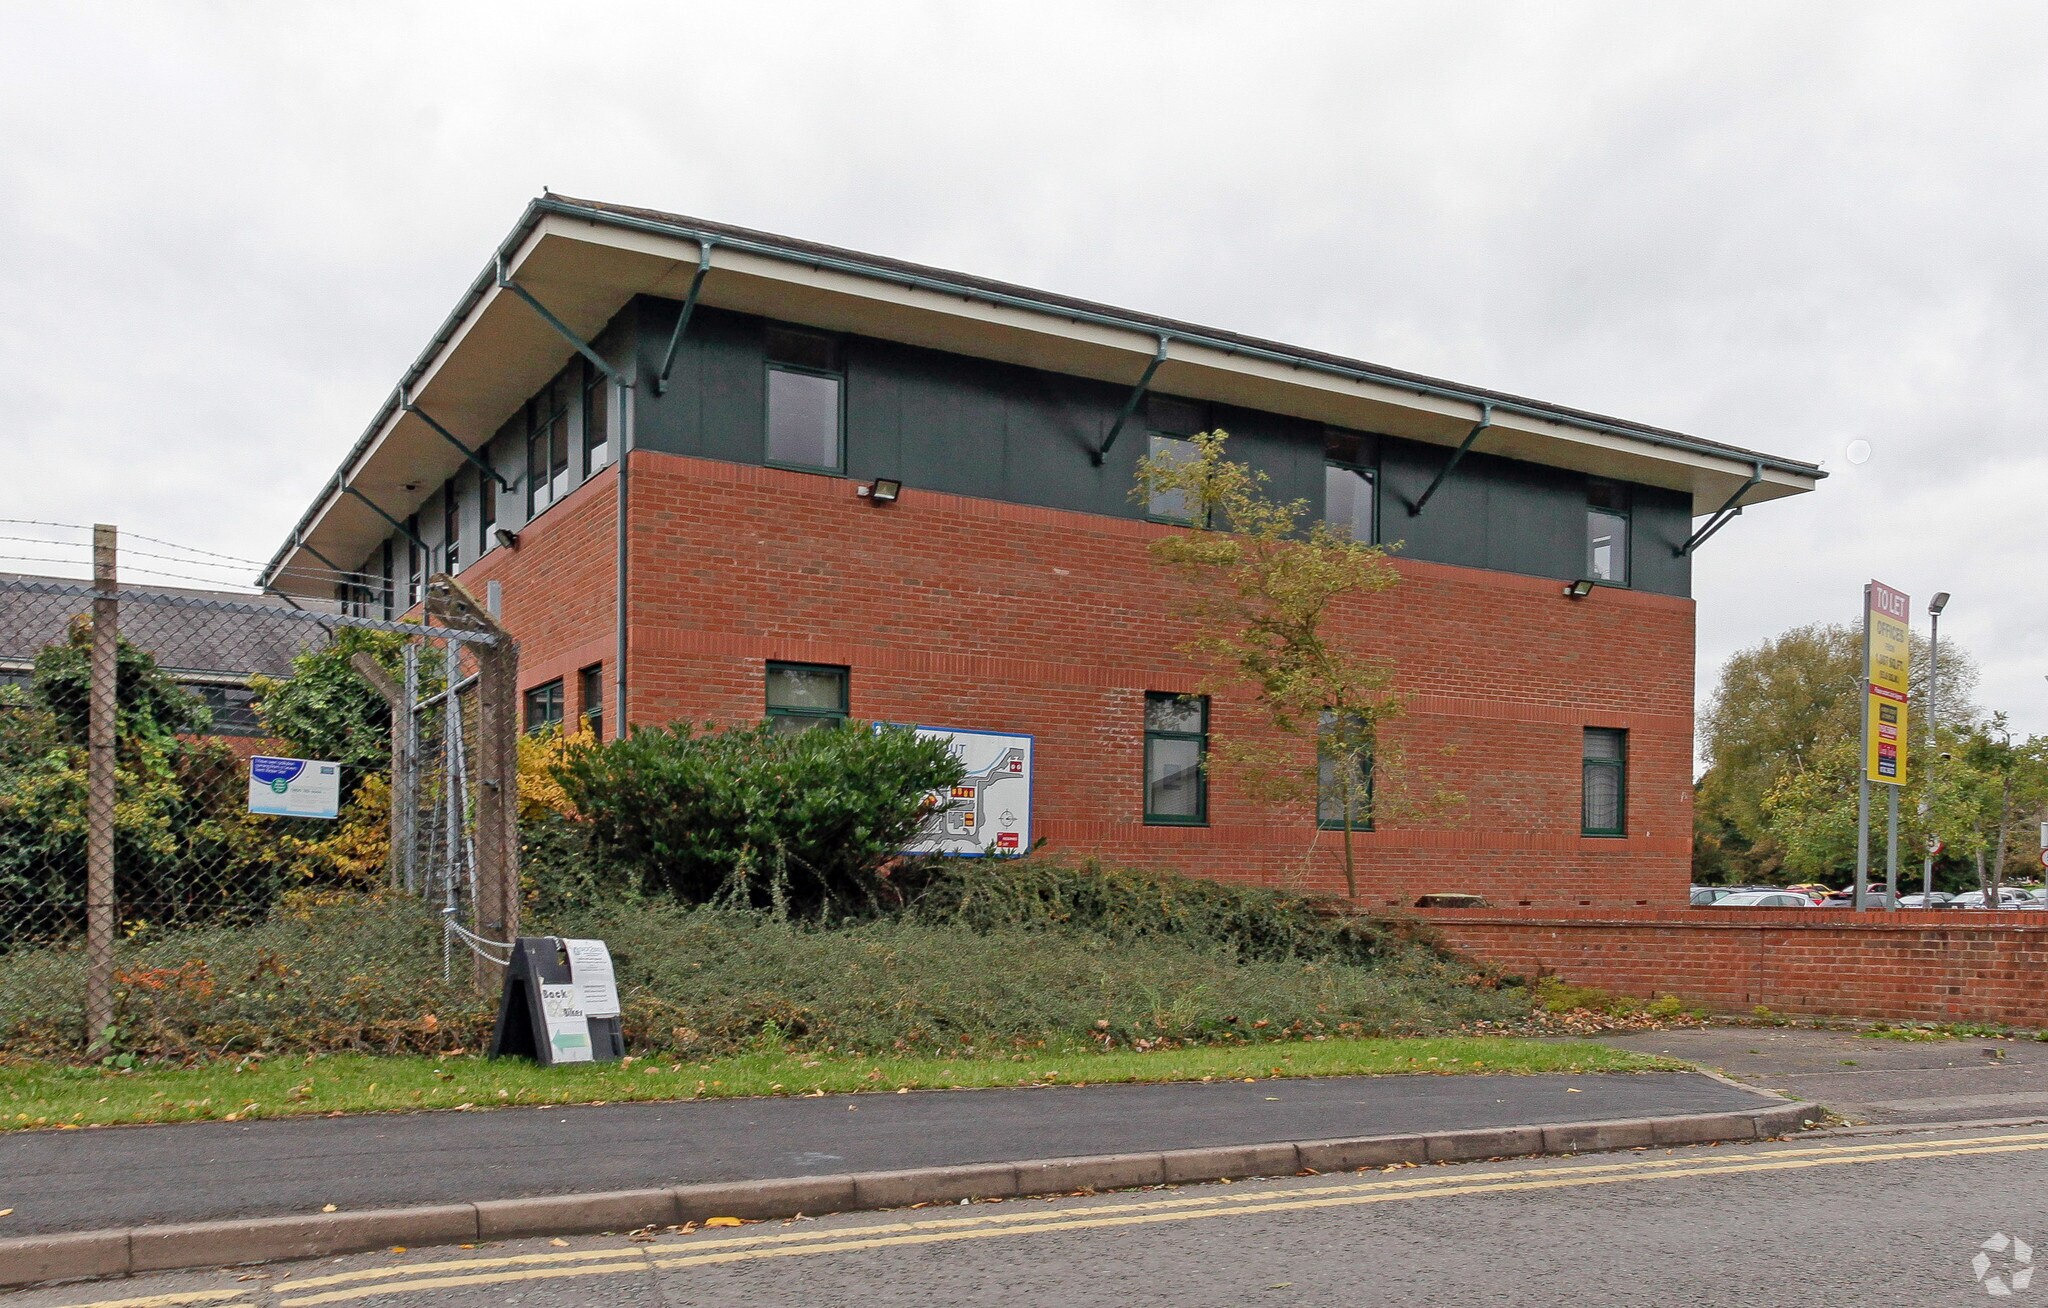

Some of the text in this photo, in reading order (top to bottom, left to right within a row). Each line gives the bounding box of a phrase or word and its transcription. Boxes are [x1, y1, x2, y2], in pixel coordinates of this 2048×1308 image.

[1877, 587, 1906, 617] TO LET
[542, 989, 568, 999] Back
